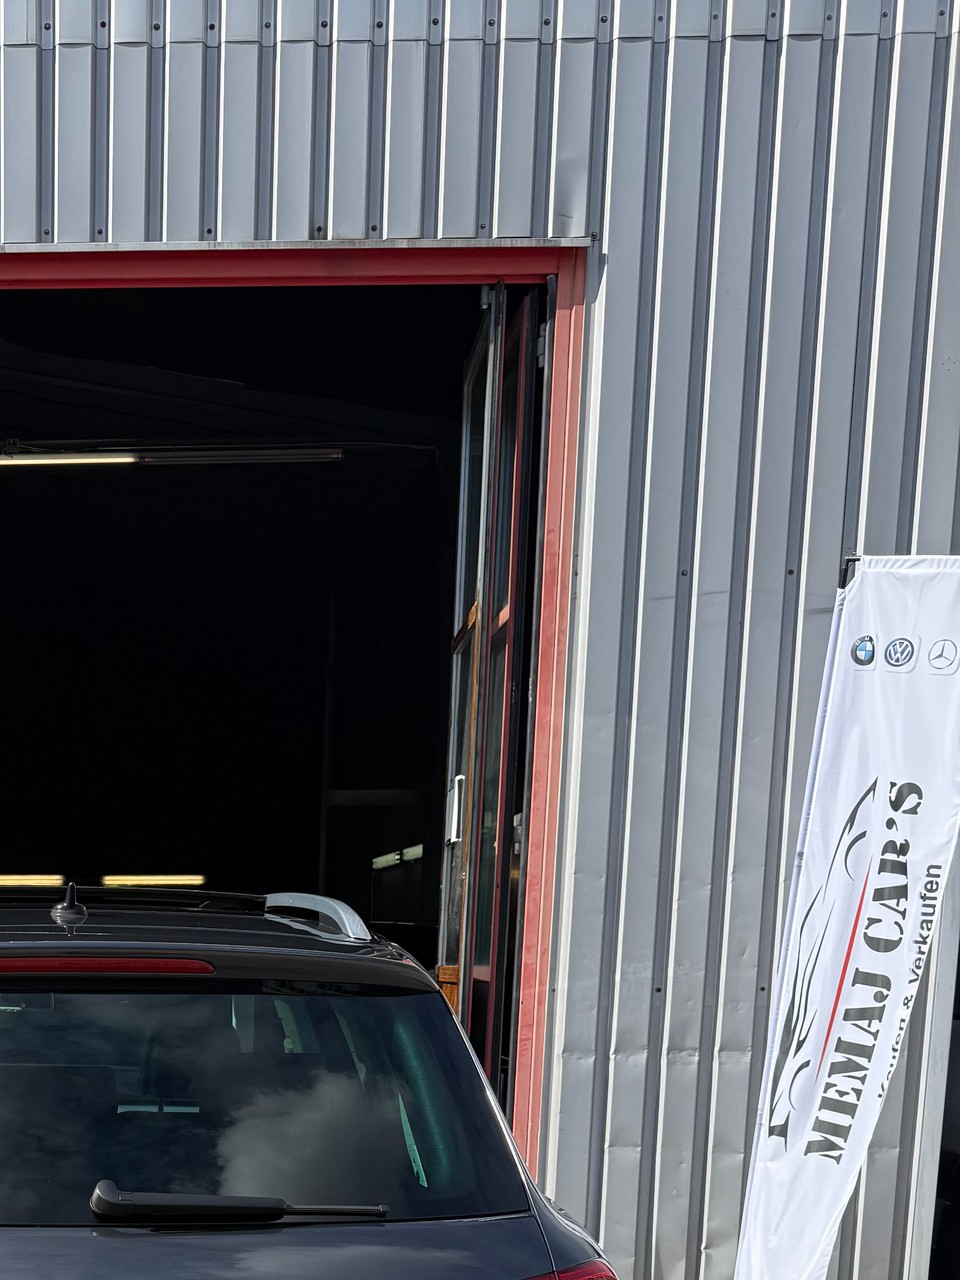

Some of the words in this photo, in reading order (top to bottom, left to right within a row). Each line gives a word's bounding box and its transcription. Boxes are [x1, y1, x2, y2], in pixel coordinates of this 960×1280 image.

[803, 967, 892, 1164] MEMAJ
[862, 781, 924, 954] CAR'S
[908, 864, 942, 985] Verkaufen
[903, 993, 914, 1009] &
